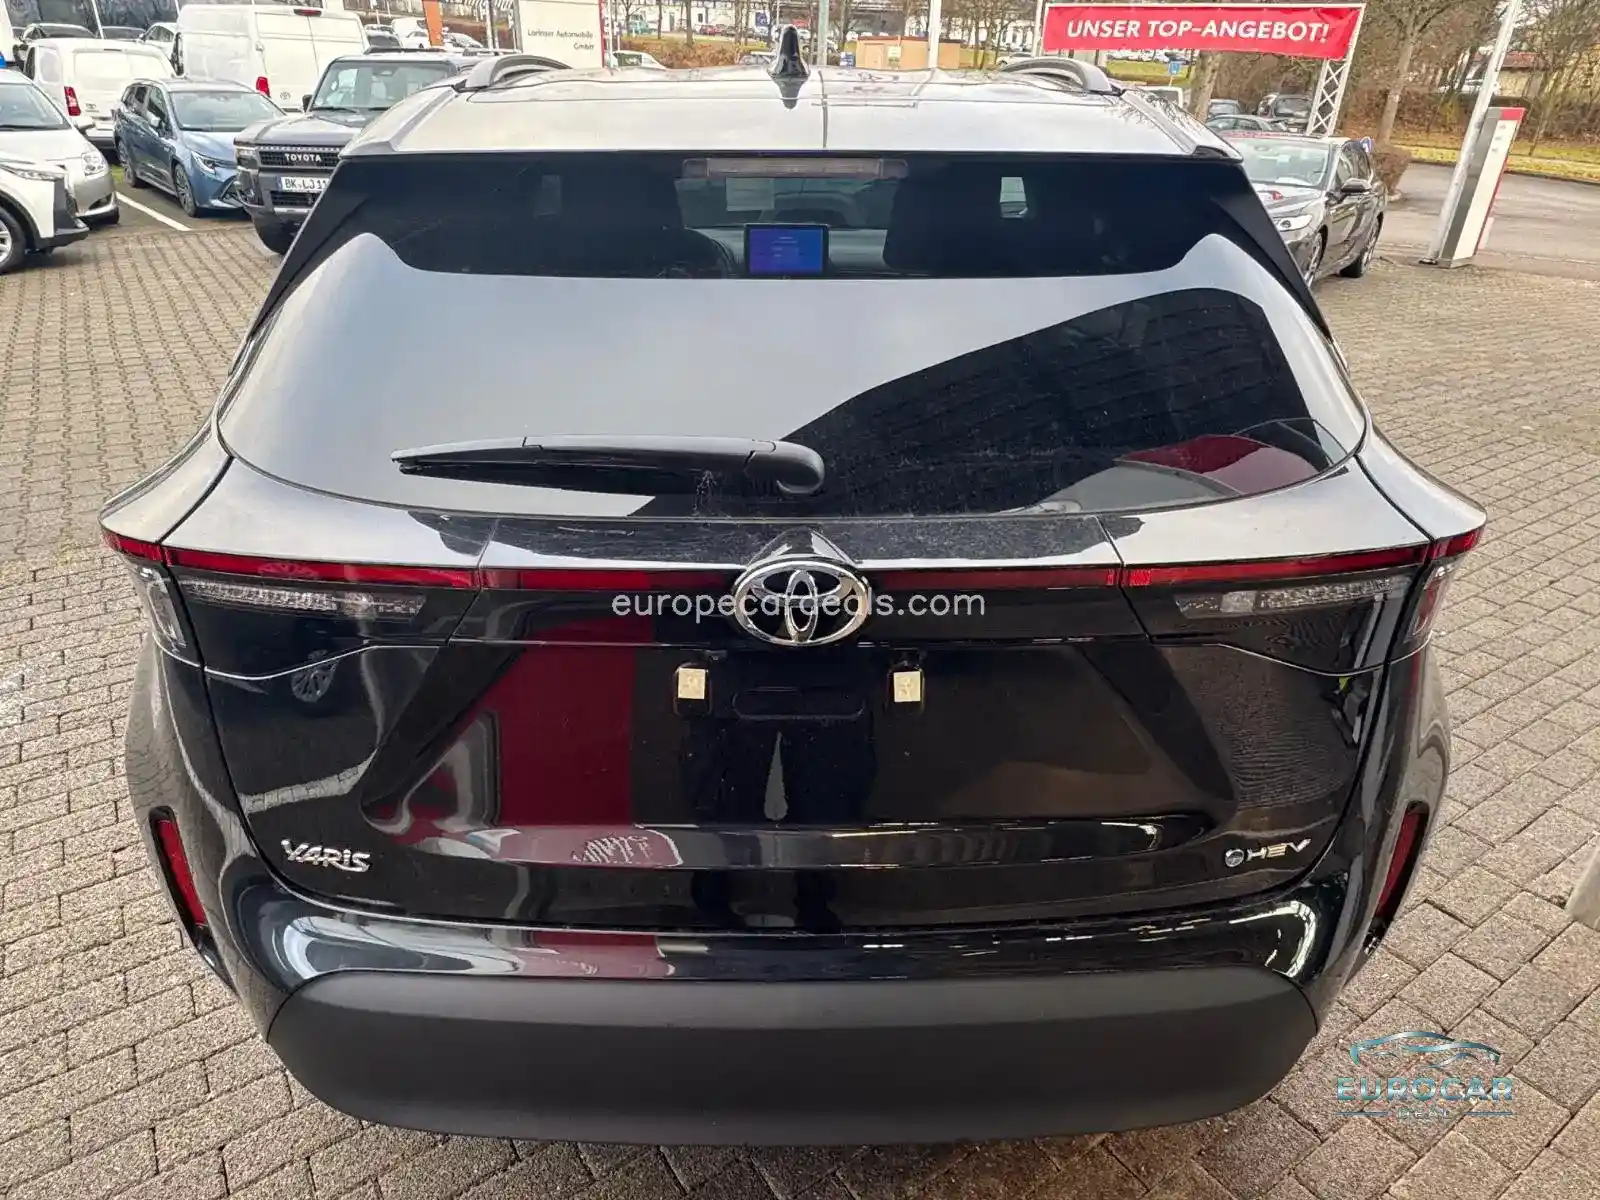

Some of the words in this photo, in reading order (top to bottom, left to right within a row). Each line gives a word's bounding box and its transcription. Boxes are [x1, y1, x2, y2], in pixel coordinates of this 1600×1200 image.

[1067, 20, 1140, 38] UNSER
[1147, 19, 1330, 44] TOP-ANGEBOT!
[285, 153, 322, 162] TOYOTA
[280, 838, 371, 873] YARIS
[1246, 839, 1312, 861] HEV
